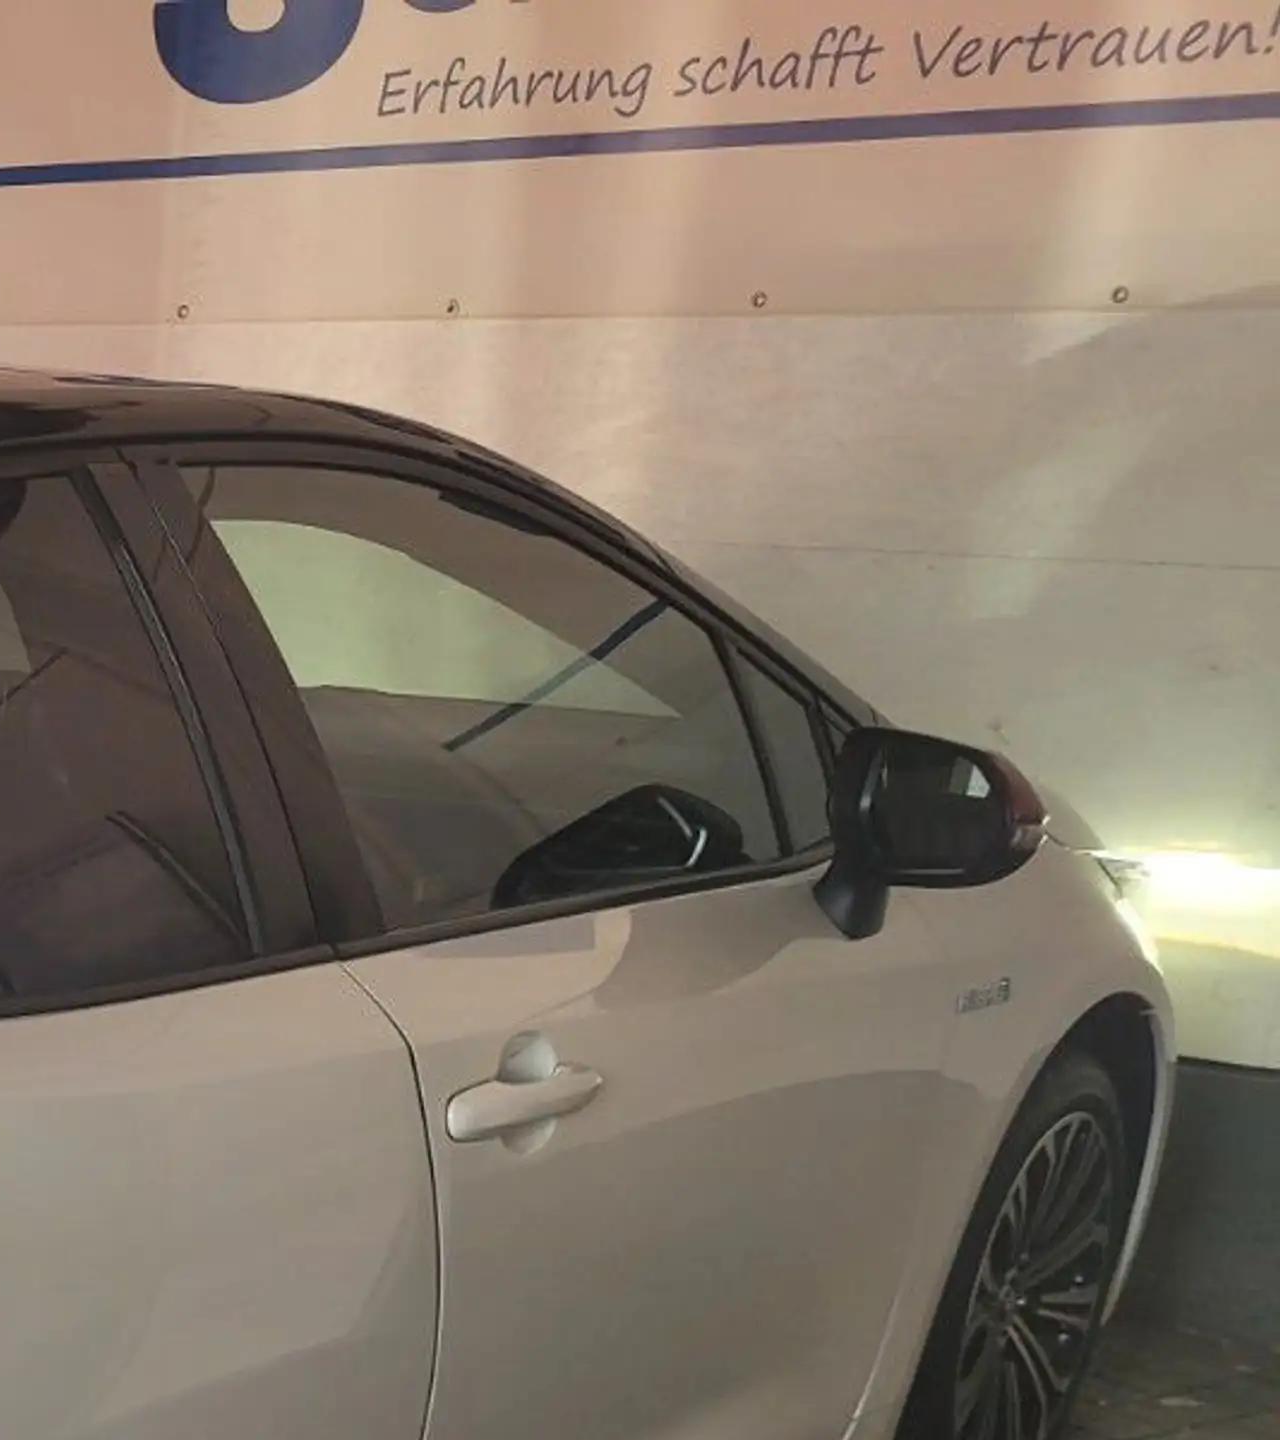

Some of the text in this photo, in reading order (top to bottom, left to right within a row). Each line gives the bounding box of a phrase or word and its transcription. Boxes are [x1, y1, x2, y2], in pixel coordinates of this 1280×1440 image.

[376, 4, 1280, 118] Erfahrung schafft Vertrauen!
